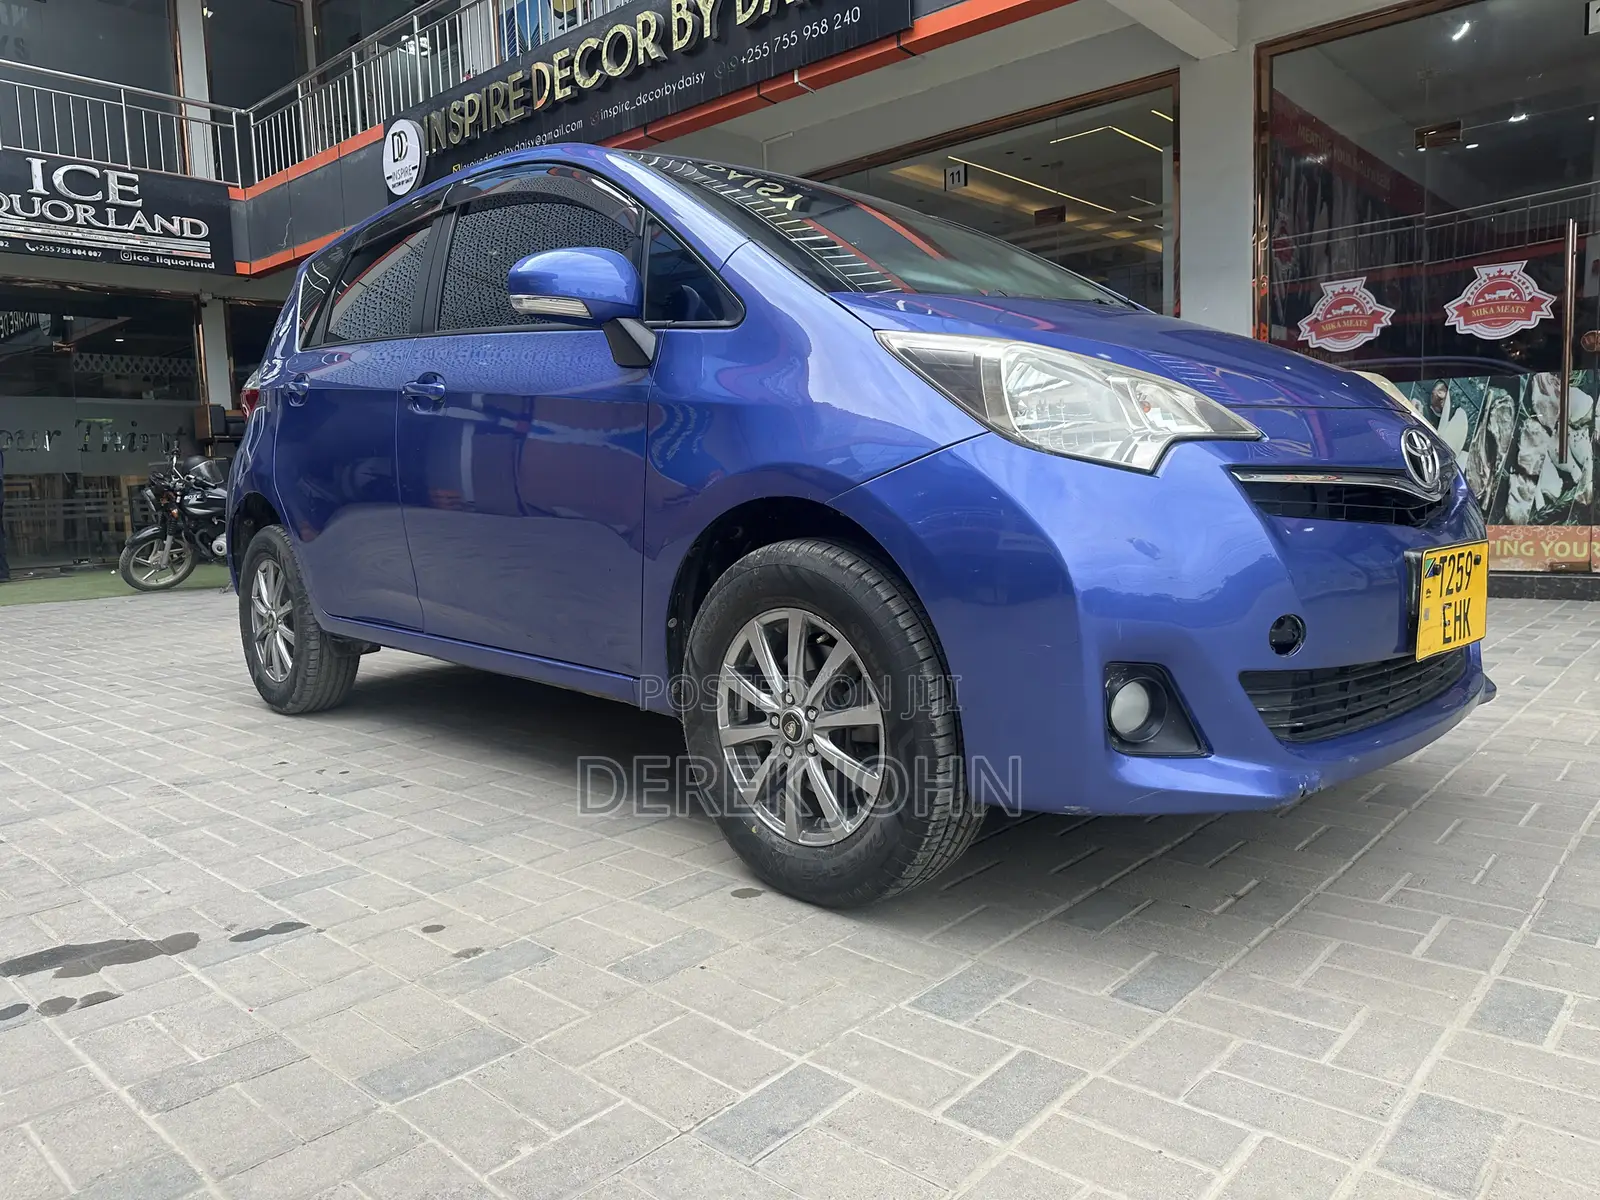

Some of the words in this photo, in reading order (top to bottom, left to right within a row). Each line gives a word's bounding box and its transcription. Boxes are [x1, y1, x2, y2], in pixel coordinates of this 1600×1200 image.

[740, 43, 770, 65] +255
[773, 30, 798, 53] 755
[802, 19, 829, 41] 958
[833, 6, 861, 31] 240
[423, 70, 528, 157] INSPIRE
[531, 10, 664, 111] DECOR
[671, 0, 716, 51] BY
[600, 69, 706, 120] inspire_decorbydaisy
[25, 156, 142, 208] ICE
[949, 169, 961, 185] 11
[133, 253, 215, 269] ice_liquorland
[1321, 320, 1341, 332] MIKA
[1342, 318, 1368, 327] MEATS
[1471, 304, 1495, 317] MIKA
[1496, 304, 1526, 314] MEATS
[1439, 550, 1473, 598] T259
[1442, 597, 1471, 645] EHK
